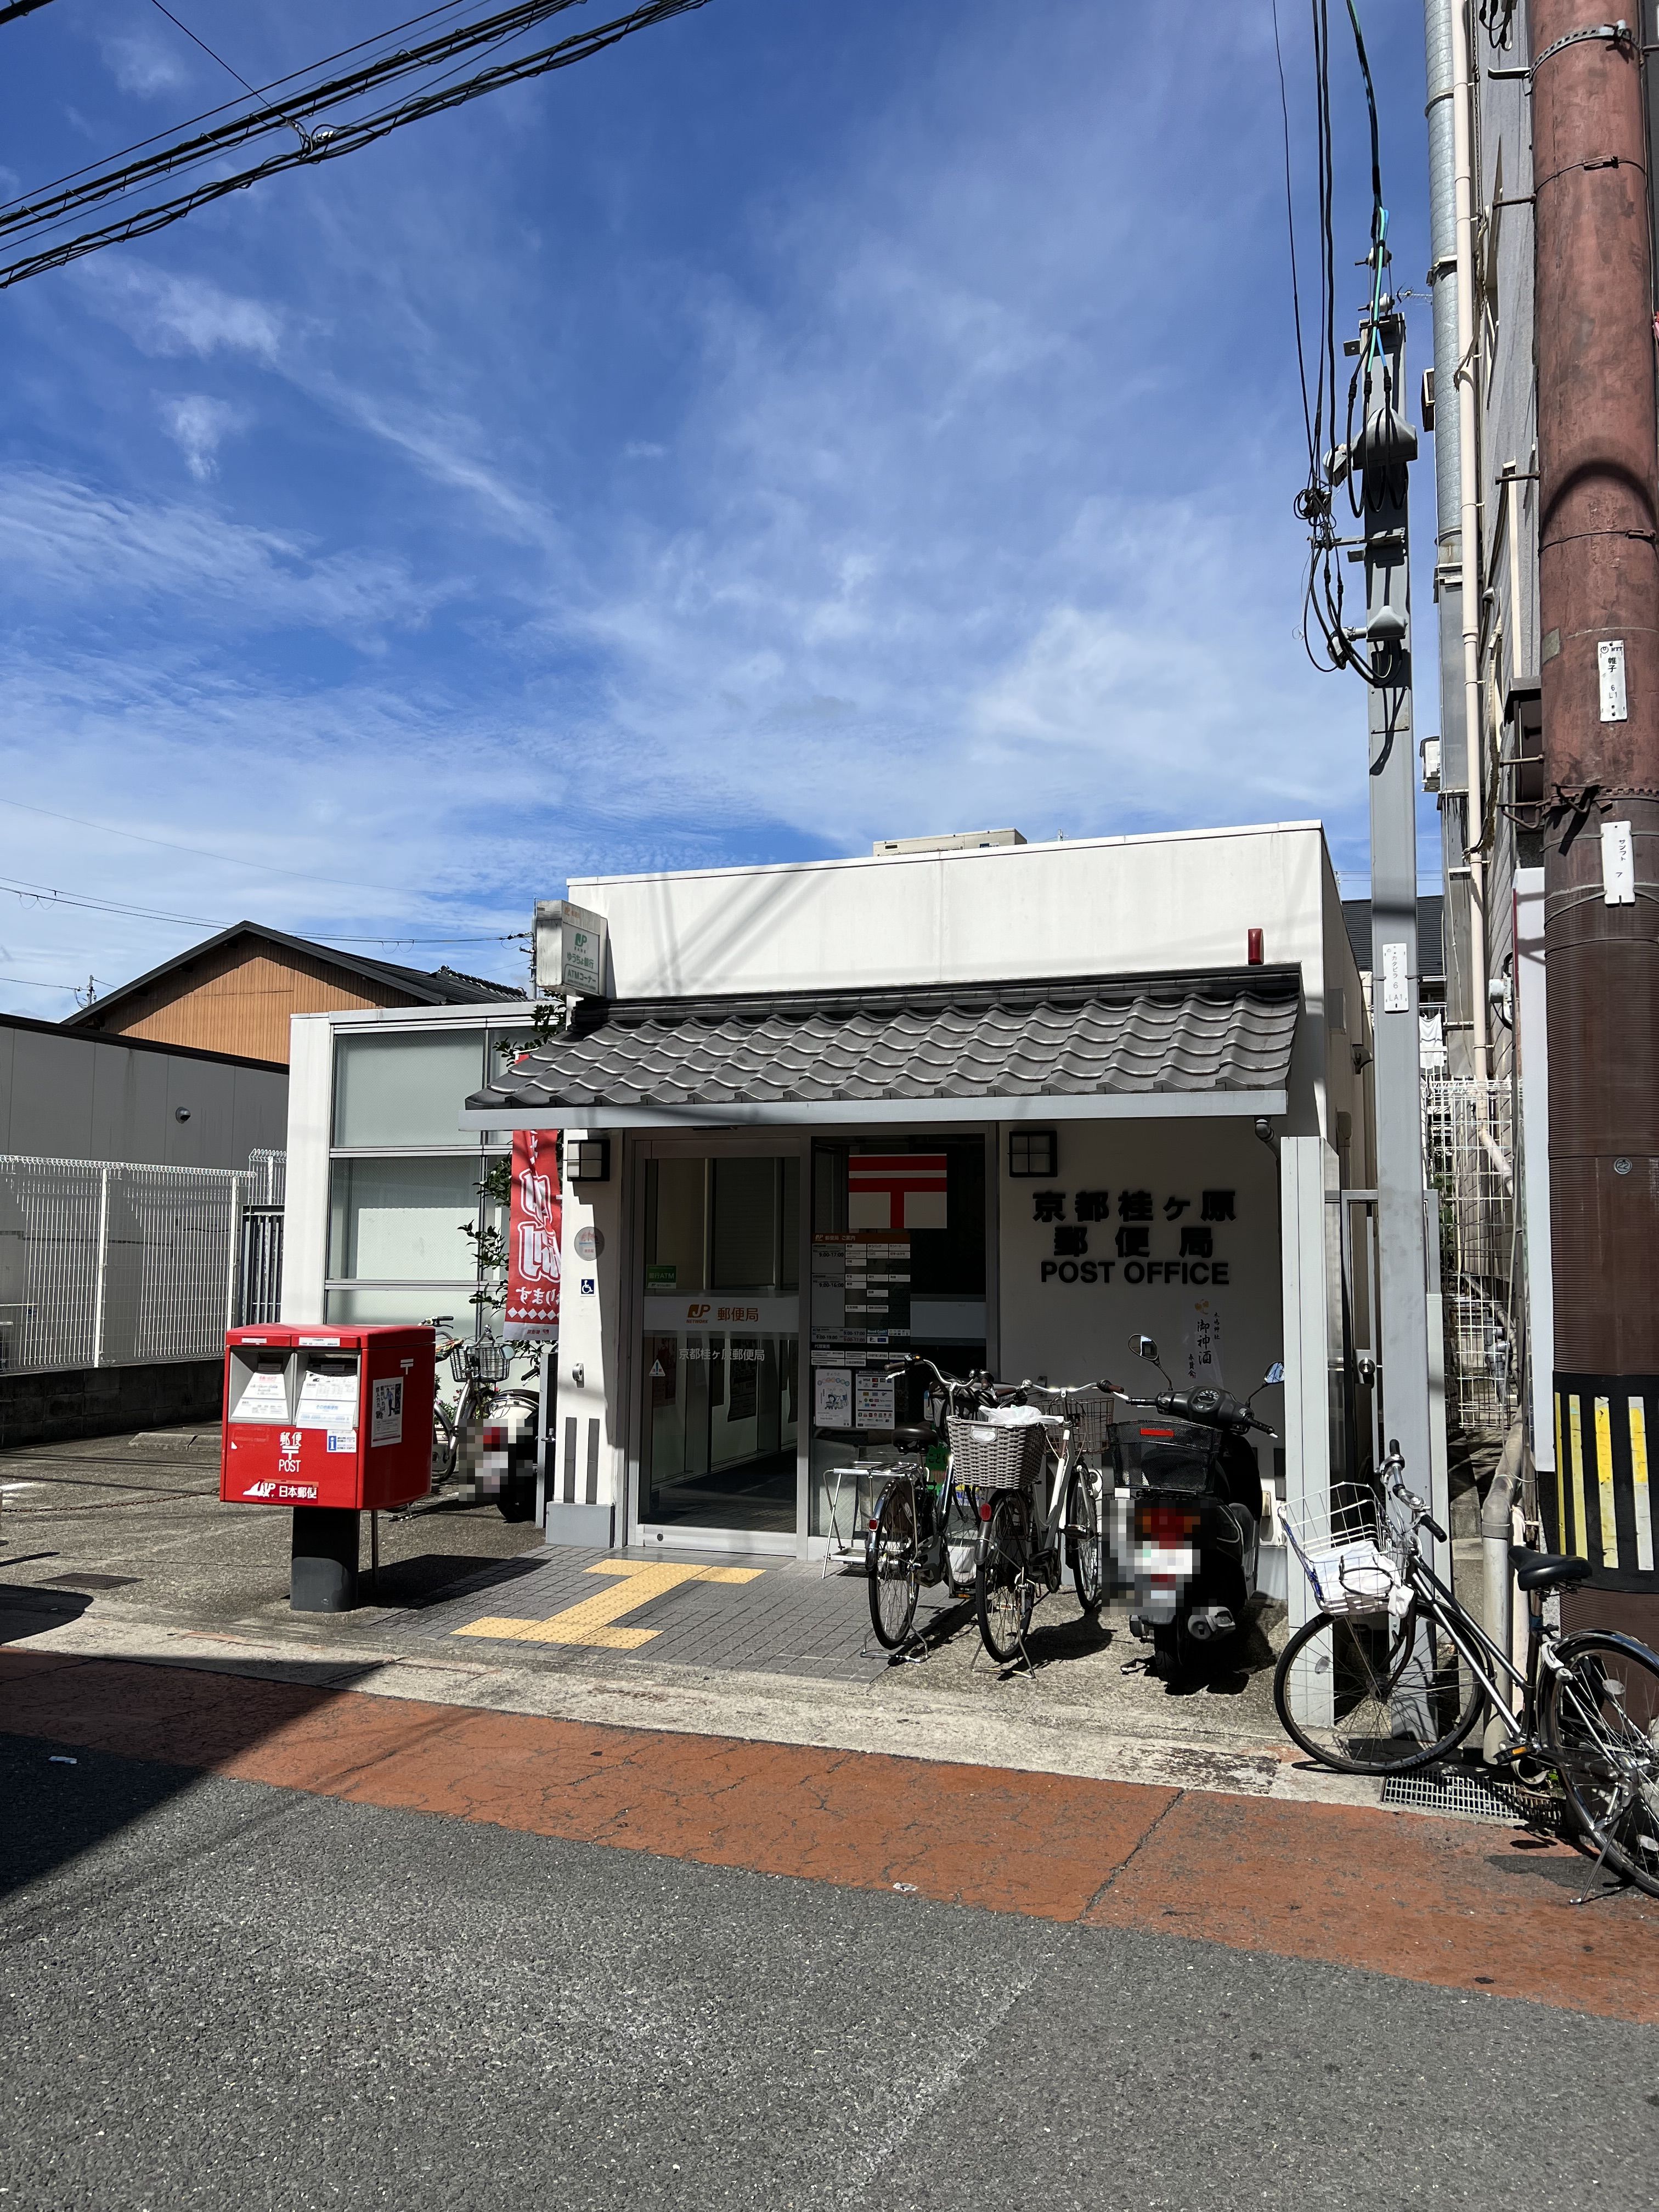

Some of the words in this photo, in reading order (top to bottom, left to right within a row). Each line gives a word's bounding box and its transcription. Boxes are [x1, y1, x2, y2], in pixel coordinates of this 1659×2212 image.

[567, 951, 594, 969] ゆうちょ銀行
[1617, 1161, 1629, 1170] 22
[1041, 1261, 1115, 1283] POST
[1124, 1262, 1229, 1285] OFFICE
[717, 1307, 759, 1322] 郵便局
[1197, 1319, 1212, 1365] 御神酒
[279, 1431, 302, 1447] 郵便
[278, 1459, 302, 1472] POST
[279, 1485, 317, 1499] 日本郵便
